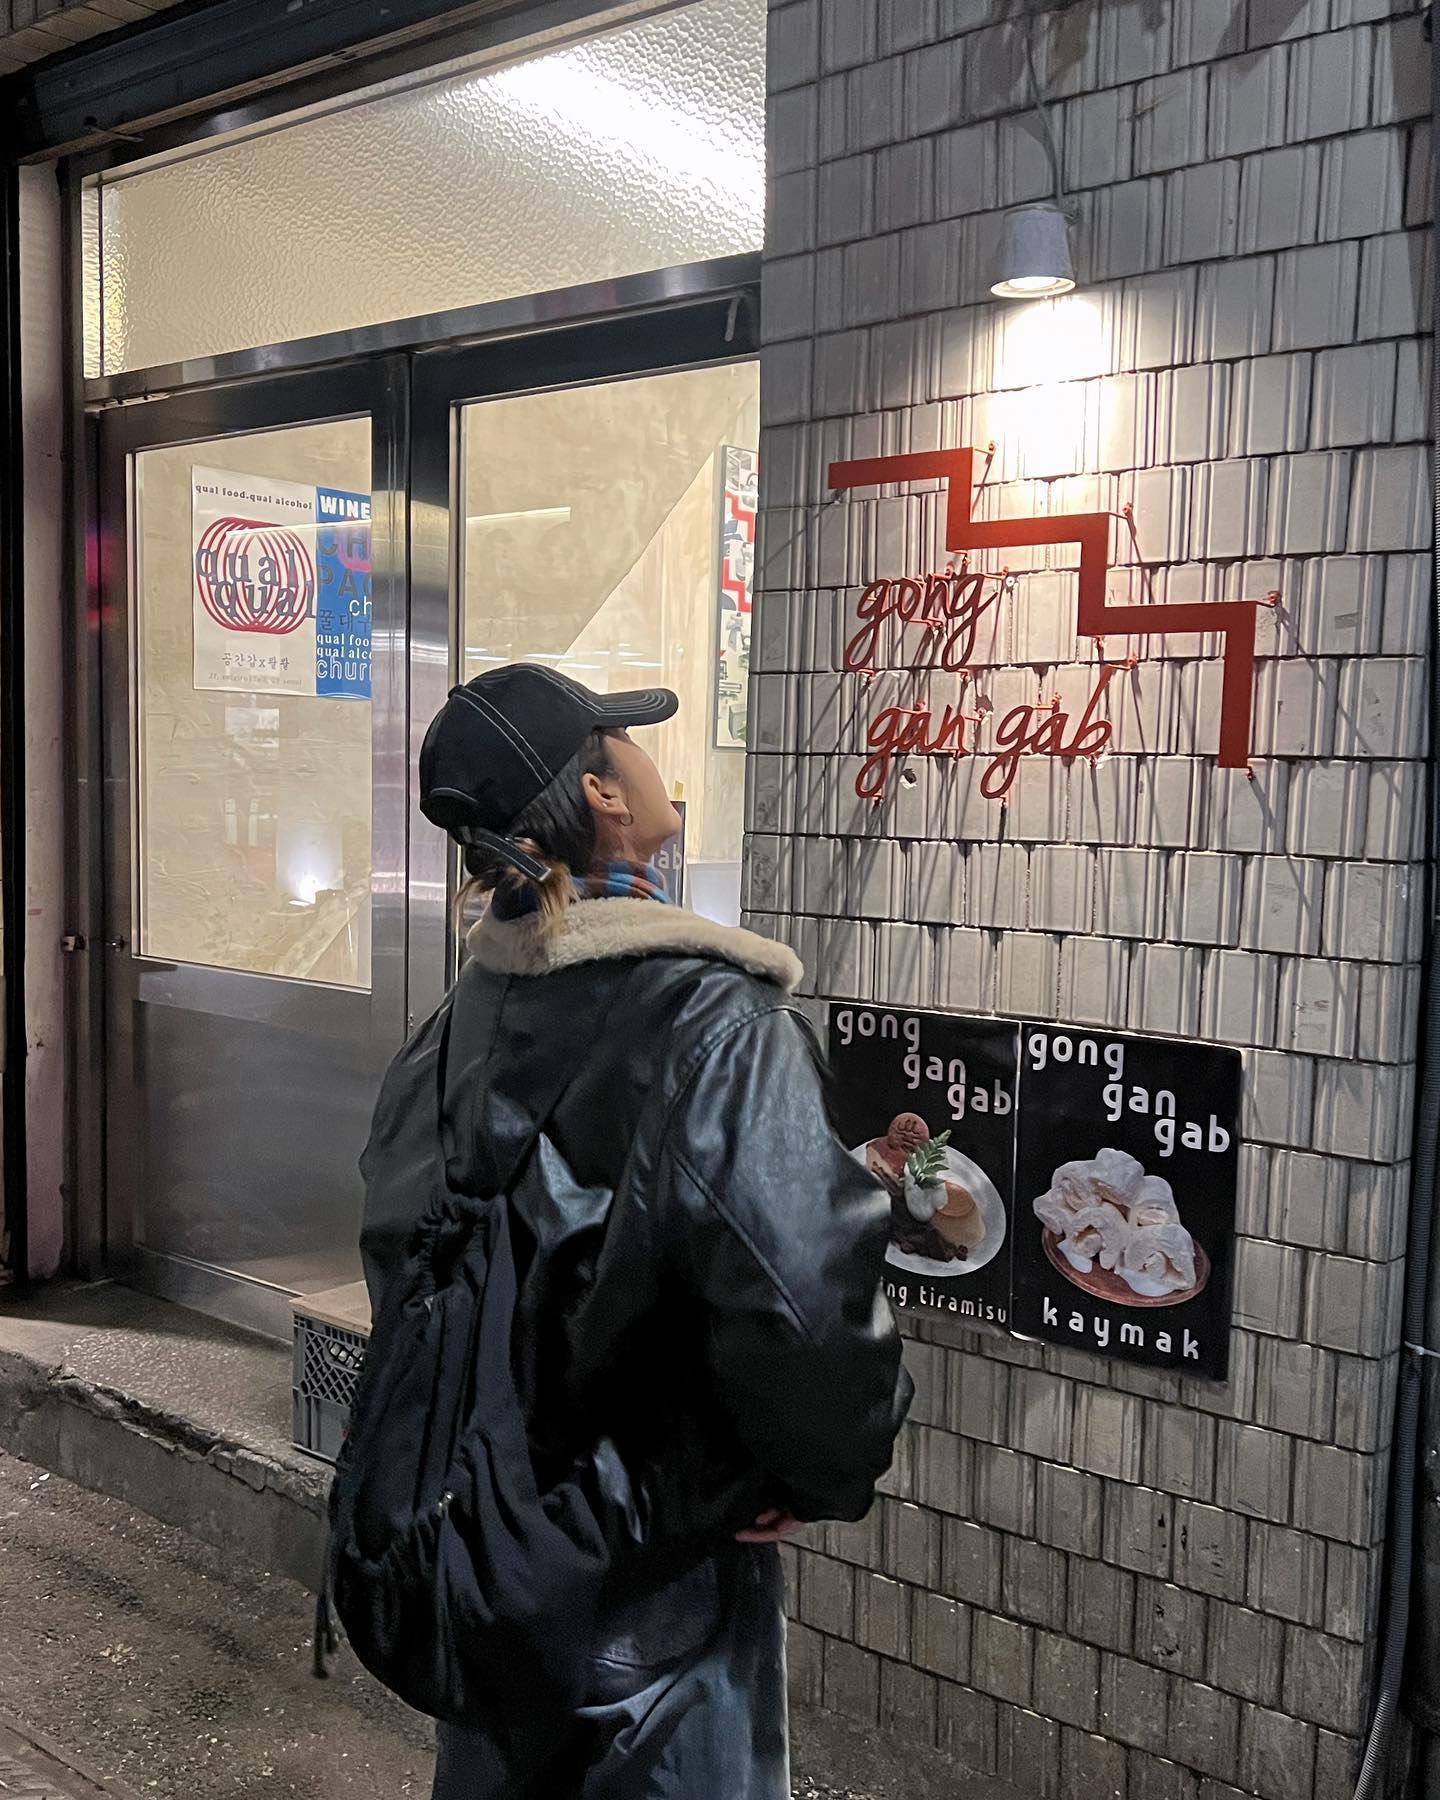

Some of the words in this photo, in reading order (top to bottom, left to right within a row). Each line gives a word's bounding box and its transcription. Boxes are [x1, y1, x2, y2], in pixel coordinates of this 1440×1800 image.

[195, 484, 219, 494] qual
[275, 498, 313, 510] alcohol
[195, 548, 300, 589] qual
[214, 579, 317, 619] qual
[316, 632, 345, 645] qual
[349, 634, 370, 647] foo
[843, 572, 998, 672] gong
[316, 646, 345, 658] qual
[855, 704, 971, 799] gan
[980, 664, 1113, 800] gab
[651, 843, 682, 870] ab
[836, 1009, 920, 1054] gong
[902, 1053, 966, 1090] gan
[1027, 1032, 1125, 1081] gong
[946, 1078, 1012, 1121] gab
[1102, 1082, 1176, 1122] gan
[1153, 1114, 1230, 1157] gab
[919, 1284, 1007, 1324] tiramisu
[1042, 1296, 1200, 1361] kaymak
